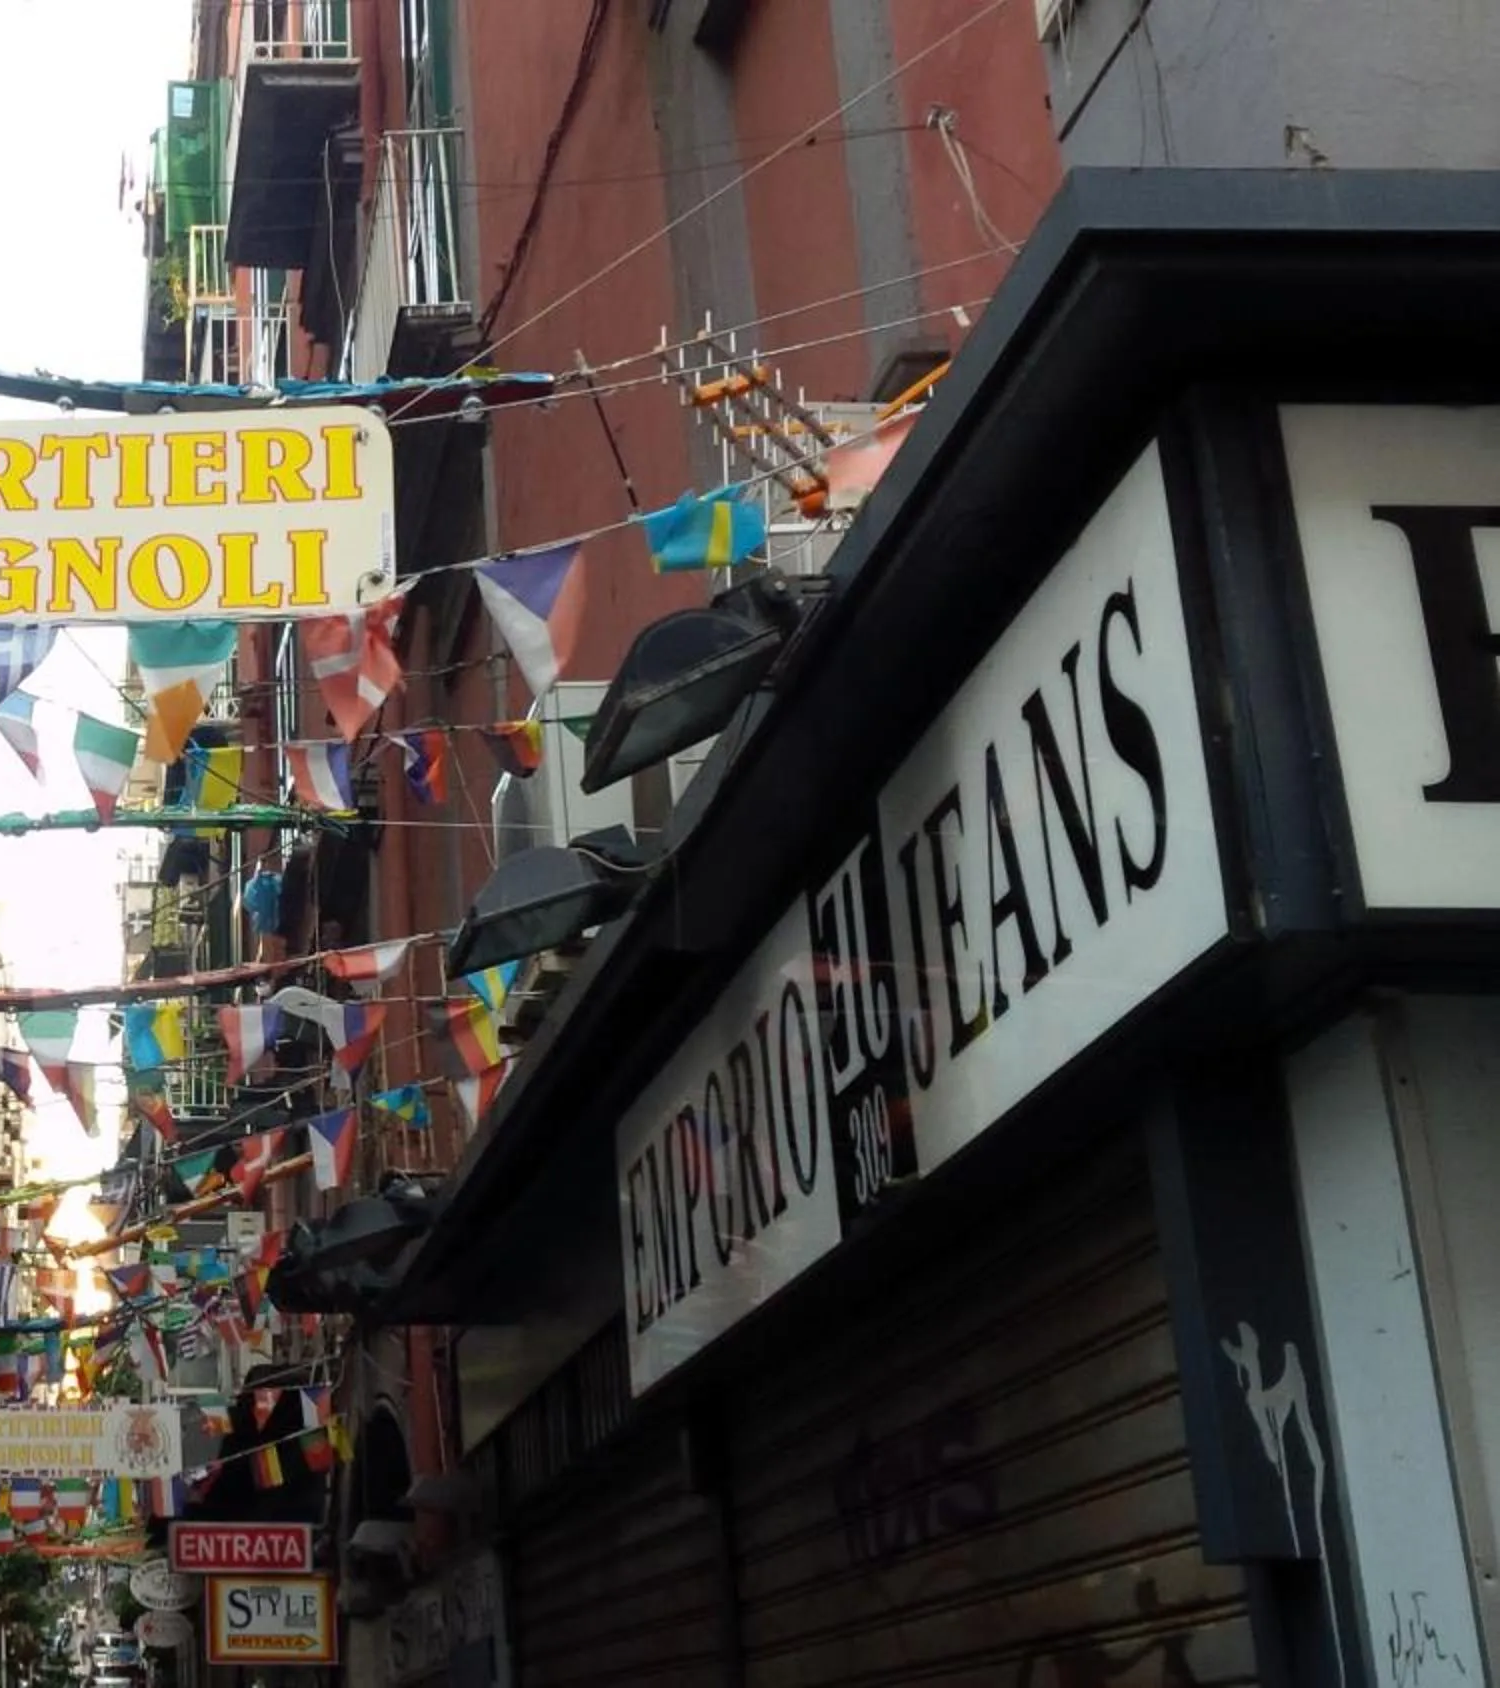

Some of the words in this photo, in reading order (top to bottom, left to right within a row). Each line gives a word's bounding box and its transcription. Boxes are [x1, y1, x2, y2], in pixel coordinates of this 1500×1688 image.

[628, 979, 818, 1335] EMPORIO
[900, 576, 1168, 1091] JEANS
[849, 1084, 893, 1205] 309
[180, 1534, 303, 1562] ENTRATA
[228, 1588, 317, 1628] STYLE
